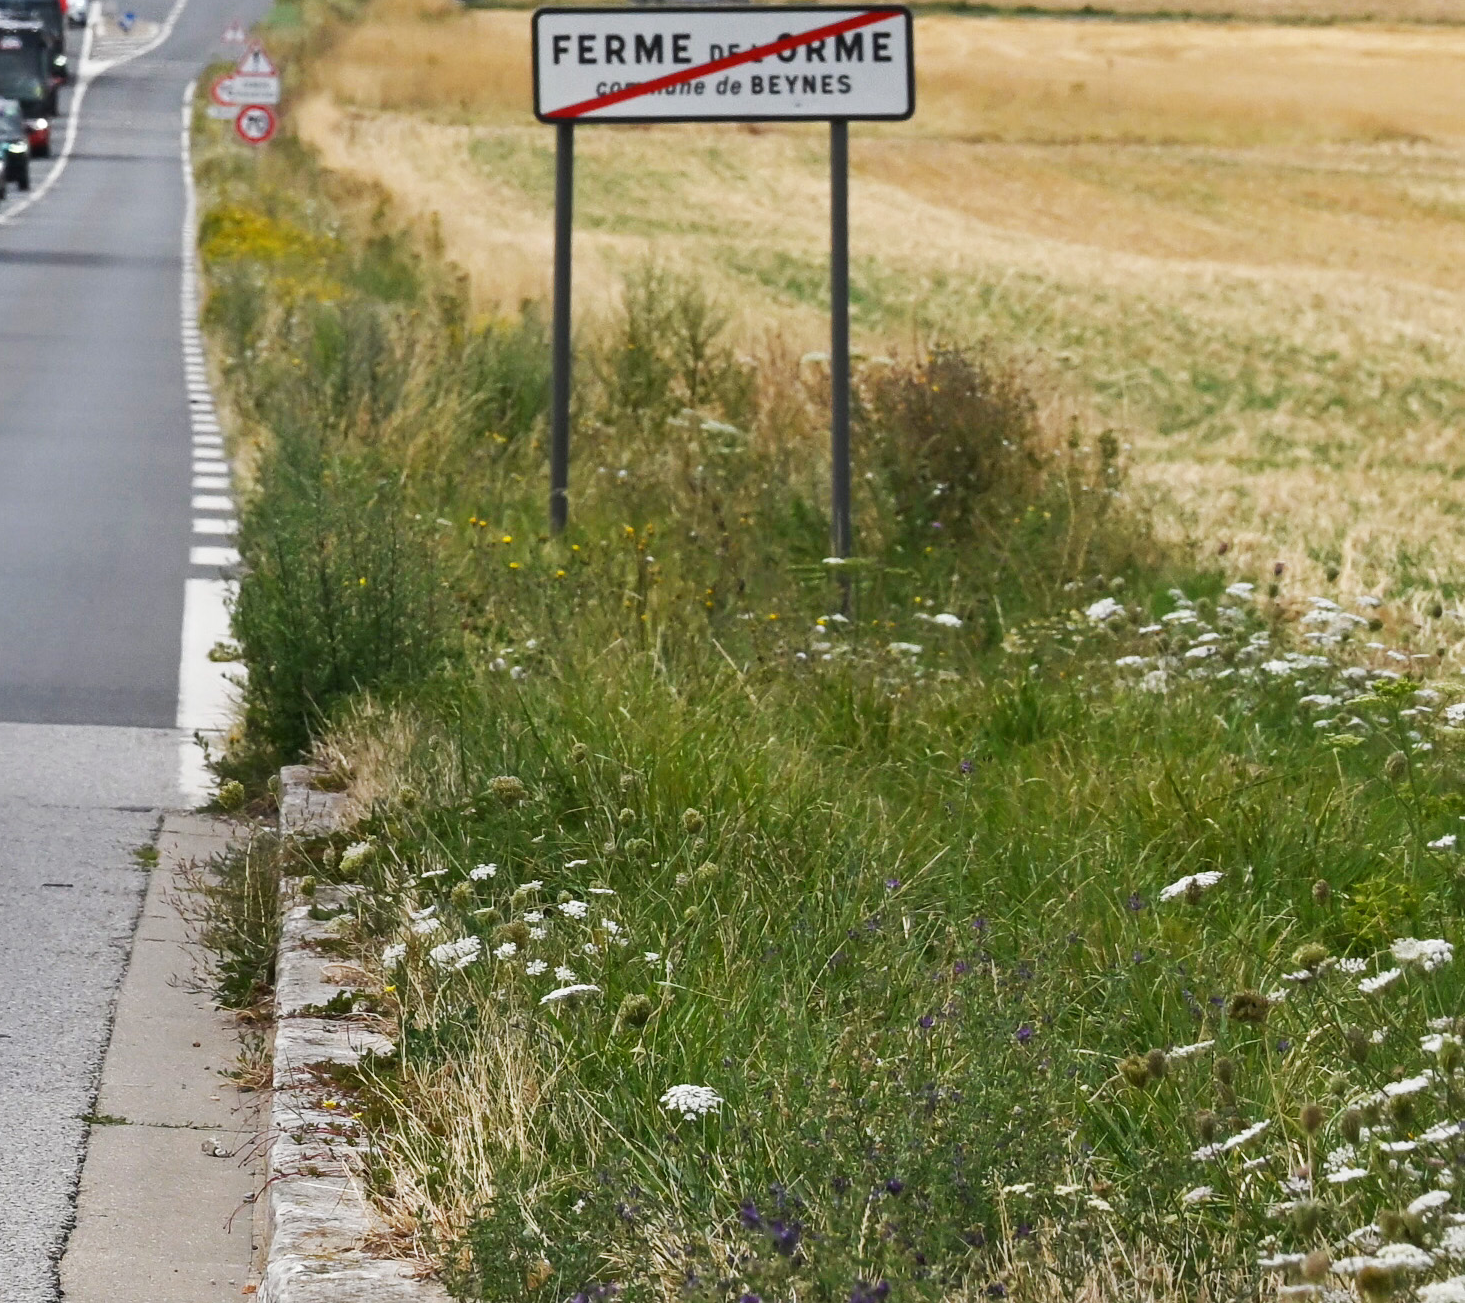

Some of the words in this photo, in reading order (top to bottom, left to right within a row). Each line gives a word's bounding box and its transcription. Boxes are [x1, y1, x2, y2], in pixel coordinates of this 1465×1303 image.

[552, 32, 693, 66] FERME
[715, 75, 742, 95] de
[750, 74, 852, 95] BEYNES
